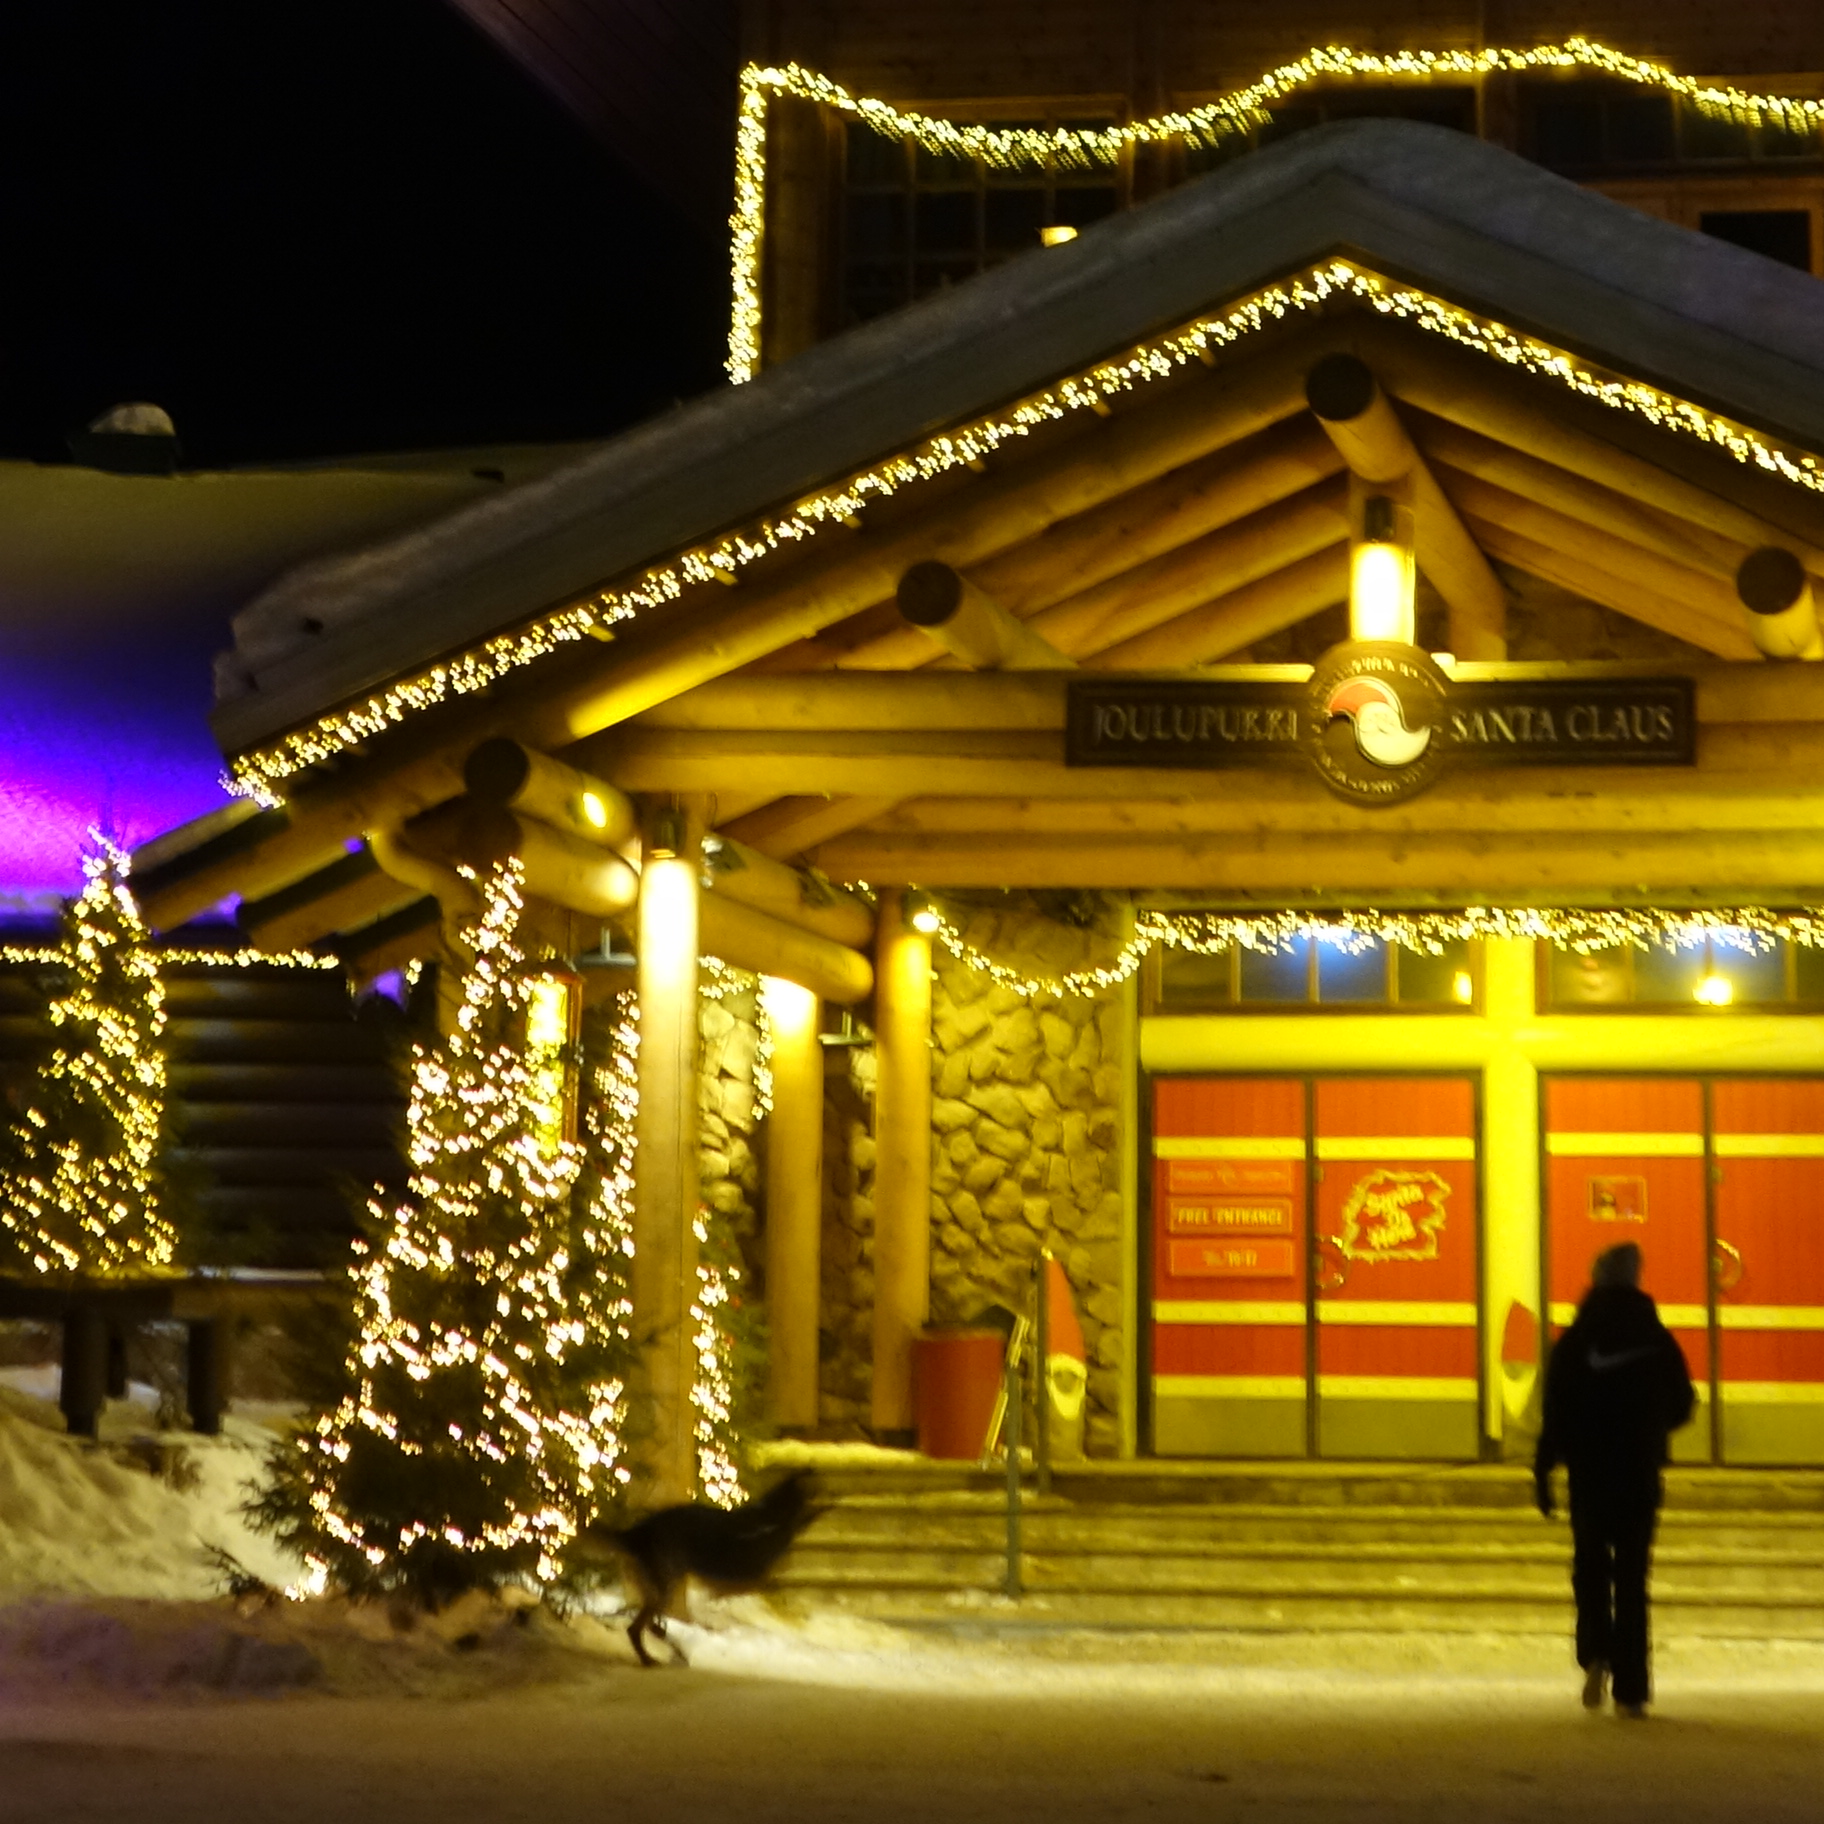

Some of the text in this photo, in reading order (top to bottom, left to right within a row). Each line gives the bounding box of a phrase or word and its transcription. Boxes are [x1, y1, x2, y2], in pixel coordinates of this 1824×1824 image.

[1093, 704, 1674, 745] JOULUPUKKI SANTA CLAUS
